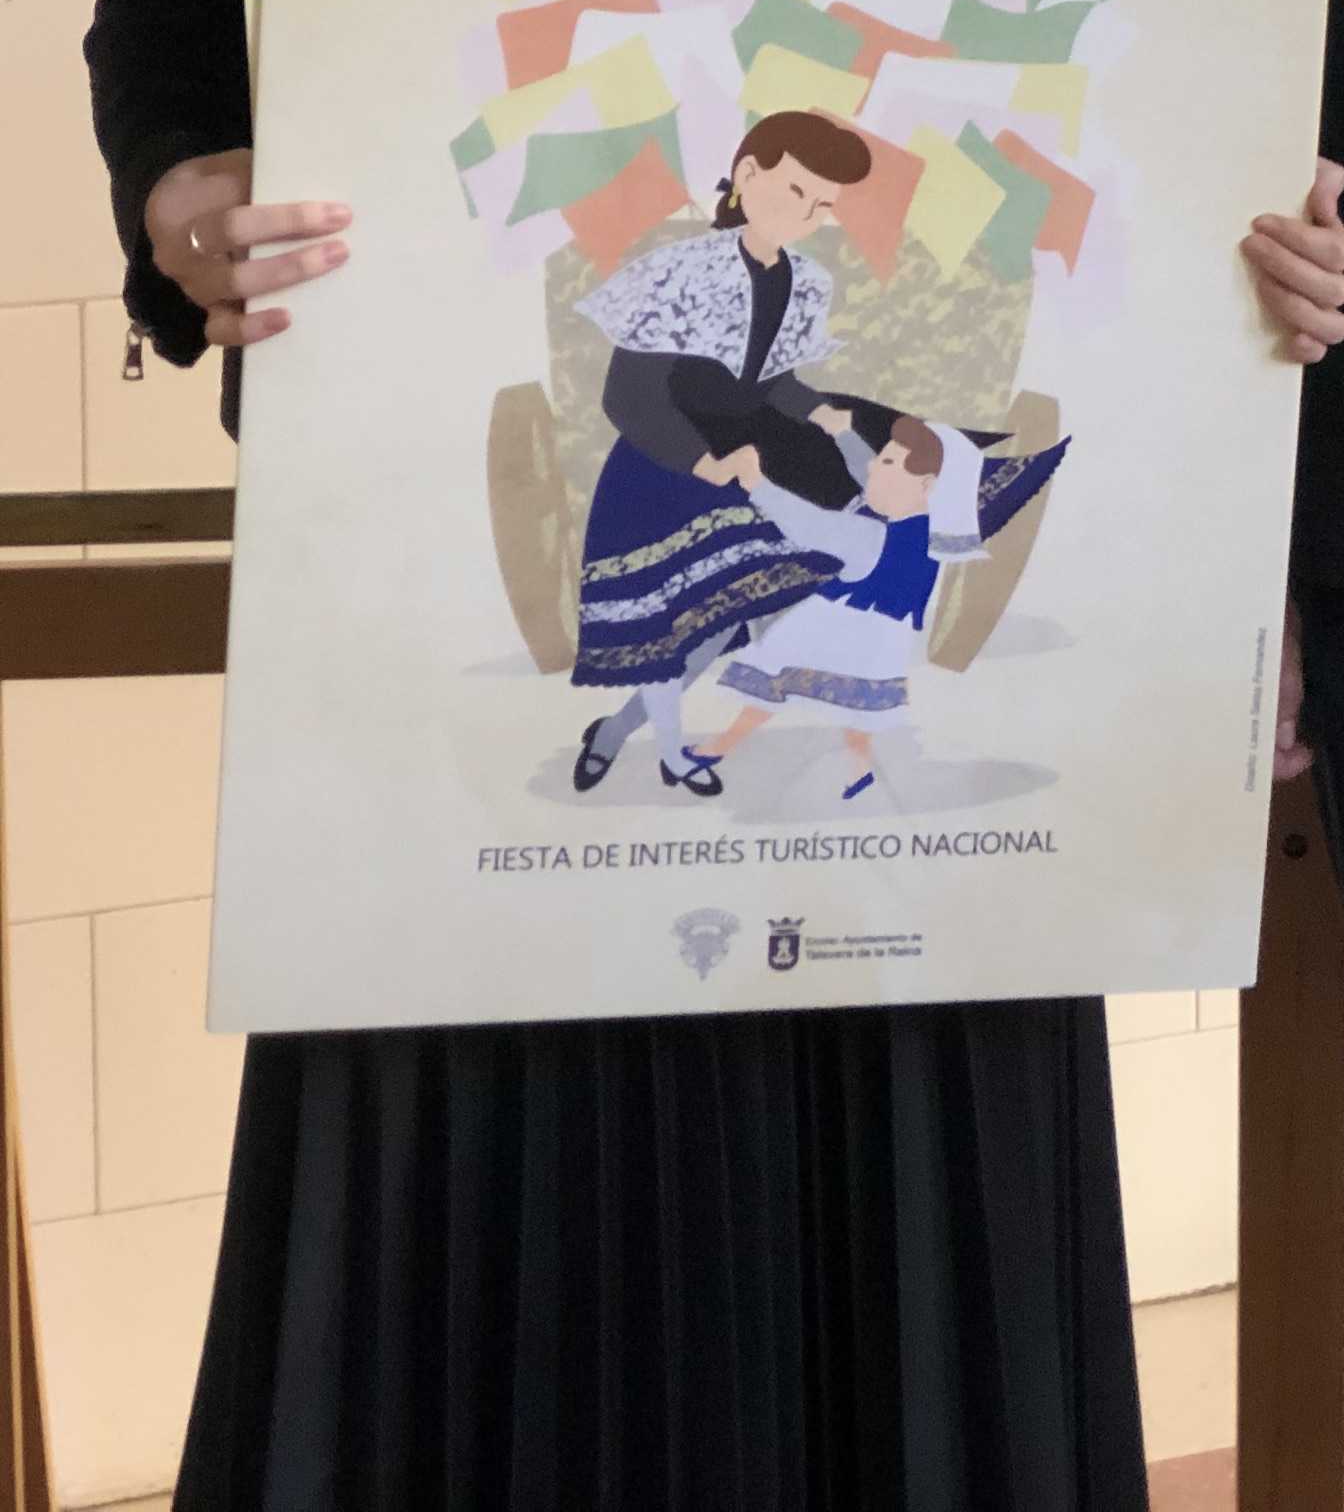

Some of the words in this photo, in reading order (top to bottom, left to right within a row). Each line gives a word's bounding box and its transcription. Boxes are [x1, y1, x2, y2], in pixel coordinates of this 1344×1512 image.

[478, 845, 572, 872] FIESTA
[582, 843, 619, 869] DE
[628, 833, 745, 867] INTERÉS
[754, 831, 901, 863] TURÍSTICO
[910, 829, 1058, 858] NACIONAL
